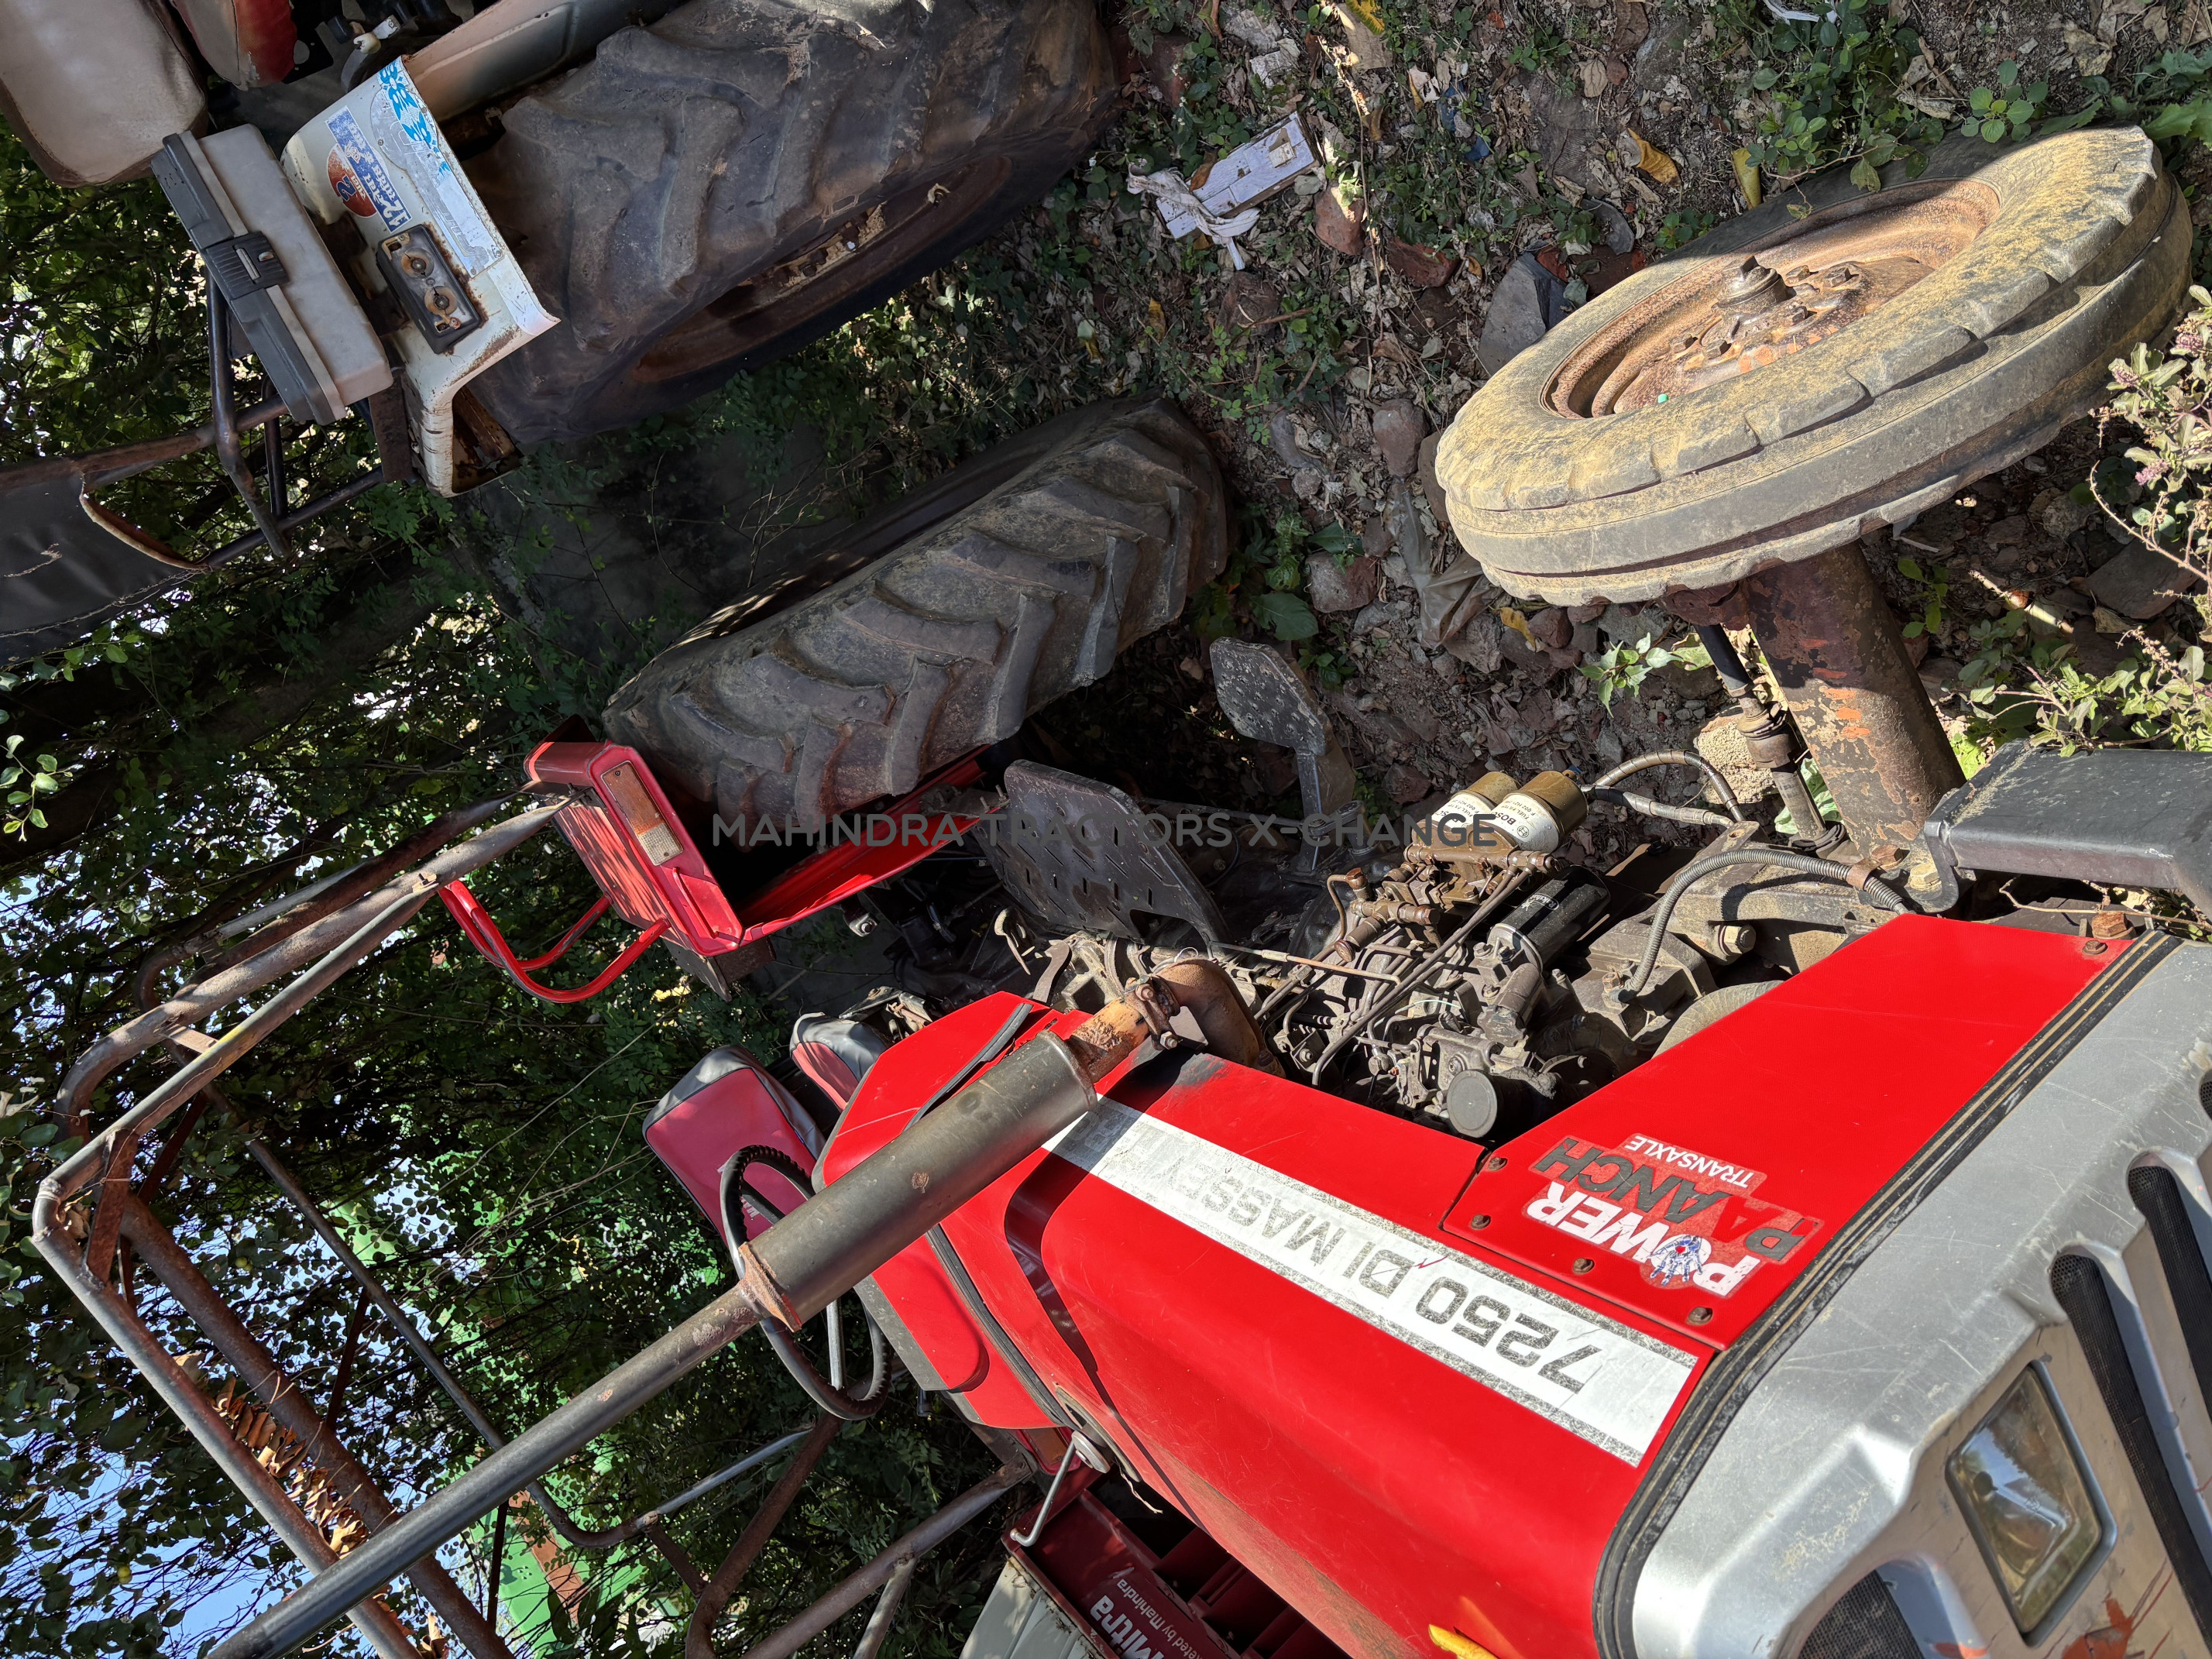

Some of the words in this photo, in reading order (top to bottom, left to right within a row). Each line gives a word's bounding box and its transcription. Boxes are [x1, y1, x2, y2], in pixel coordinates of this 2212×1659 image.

[336, 175, 357, 201] 2
[382, 199, 410, 226] 12
[1625, 1135, 1755, 1188] TRANSAXLE
[1151, 1156, 1347, 1266] MASSEY
[1534, 1138, 1818, 1261] PAANCH
[1527, 1181, 1760, 1296] POWER
[1342, 1241, 1416, 1299] DI
[1415, 1276, 1602, 1394] 7250
[1091, 1595, 1164, 1659] Mitra
[1117, 1579, 1166, 1630] Mahindra
[1163, 1625, 1177, 1642] by
